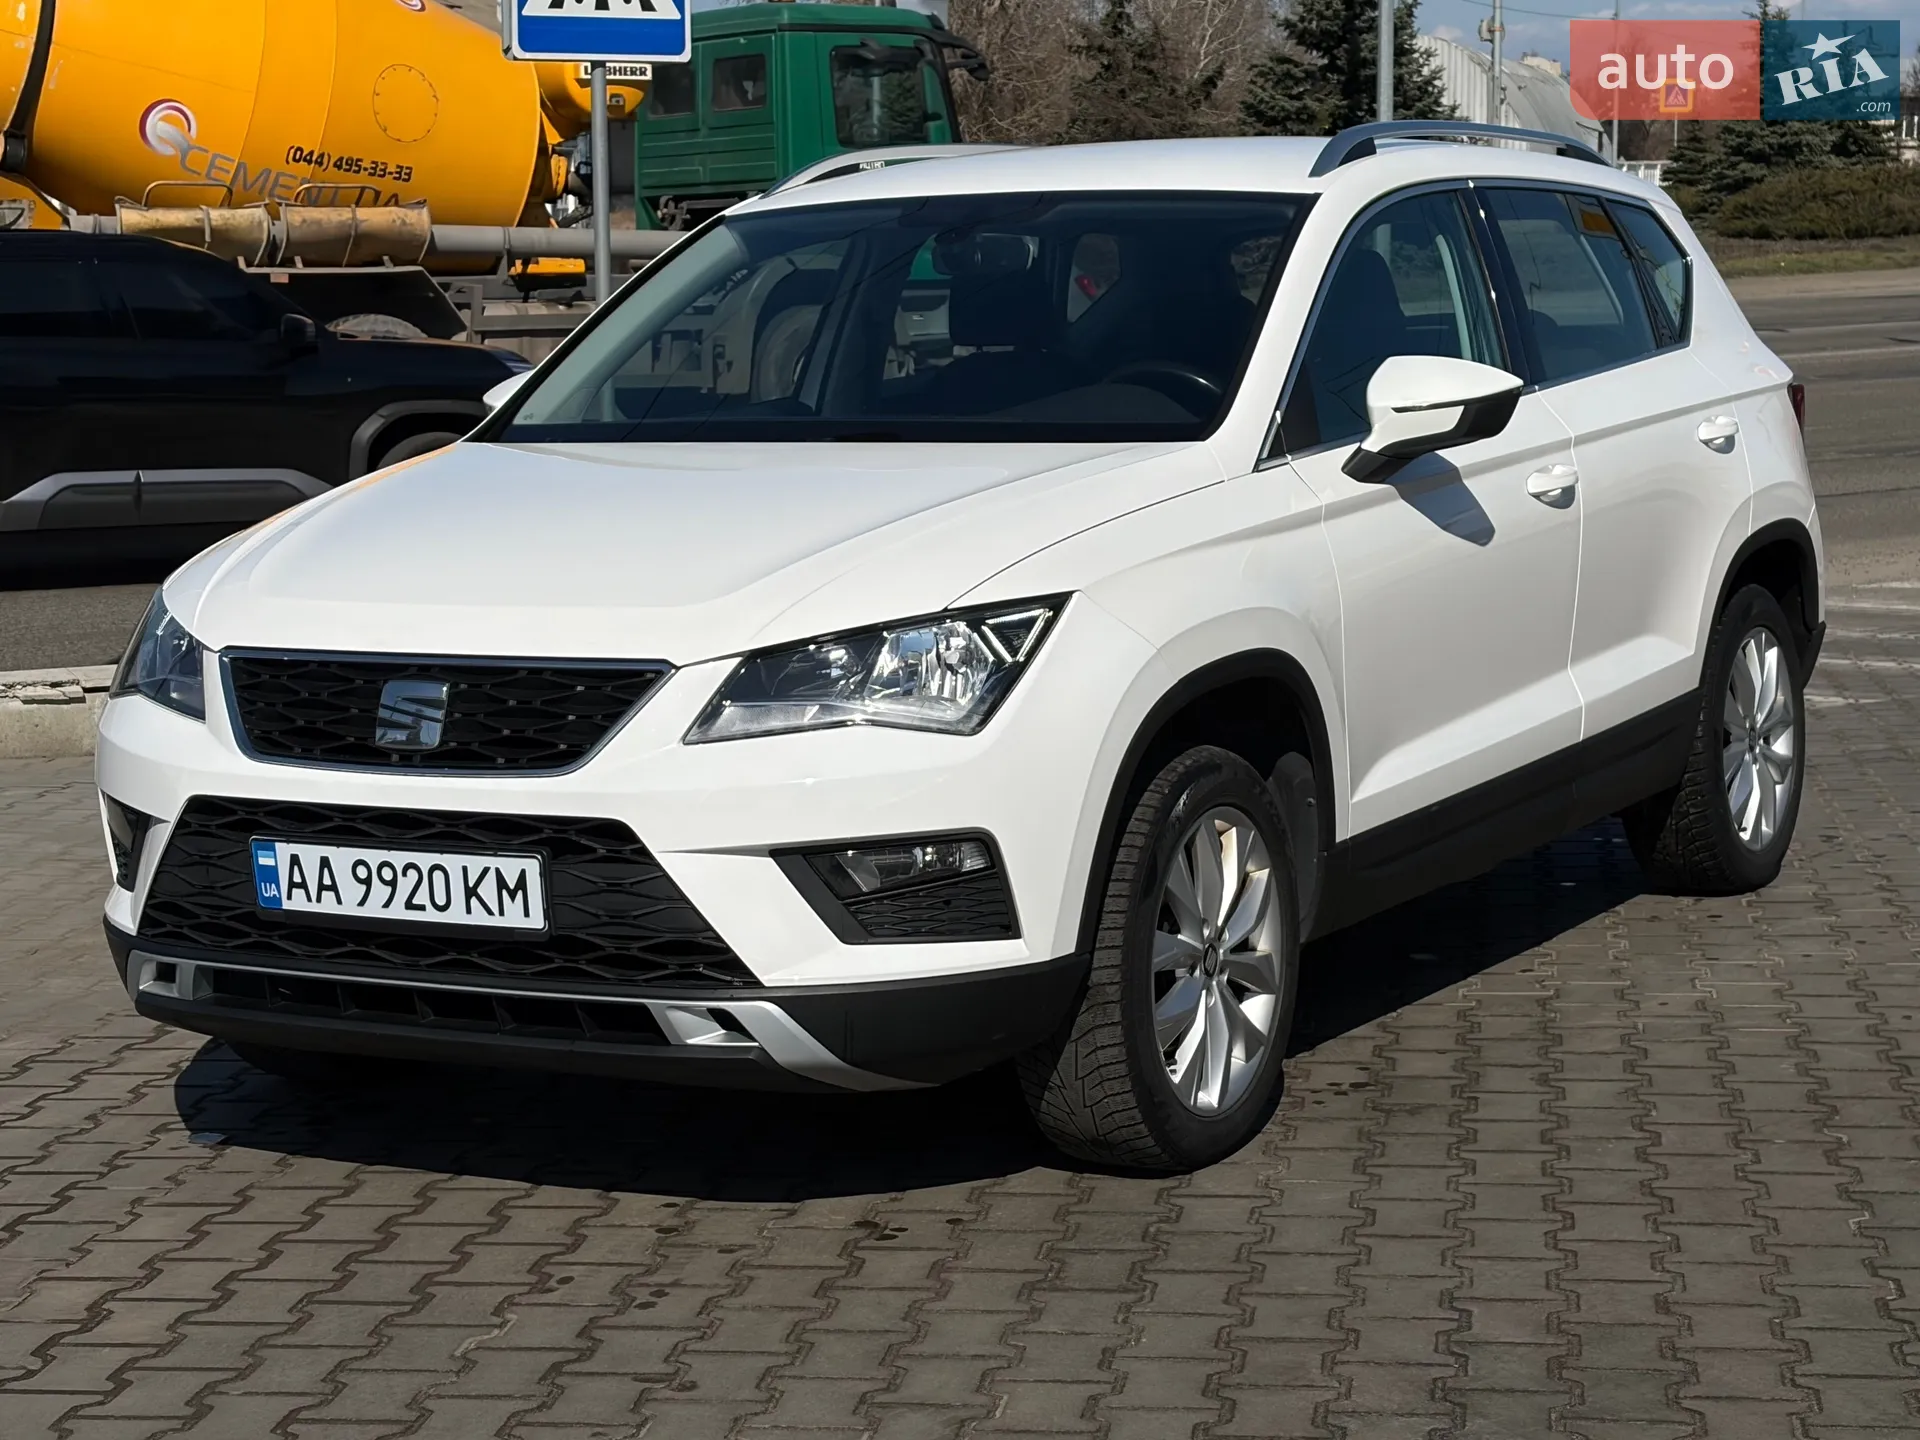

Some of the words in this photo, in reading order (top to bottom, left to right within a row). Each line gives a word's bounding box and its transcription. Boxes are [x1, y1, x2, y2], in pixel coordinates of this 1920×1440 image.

[583, 65, 648, 77] LBHERR
[285, 145, 331, 172] (044)
[332, 156, 413, 183] 495-33-33
[262, 882, 280, 898] UA
[286, 853, 343, 906] AA
[351, 858, 452, 913] 9920
[461, 865, 531, 918] KM
